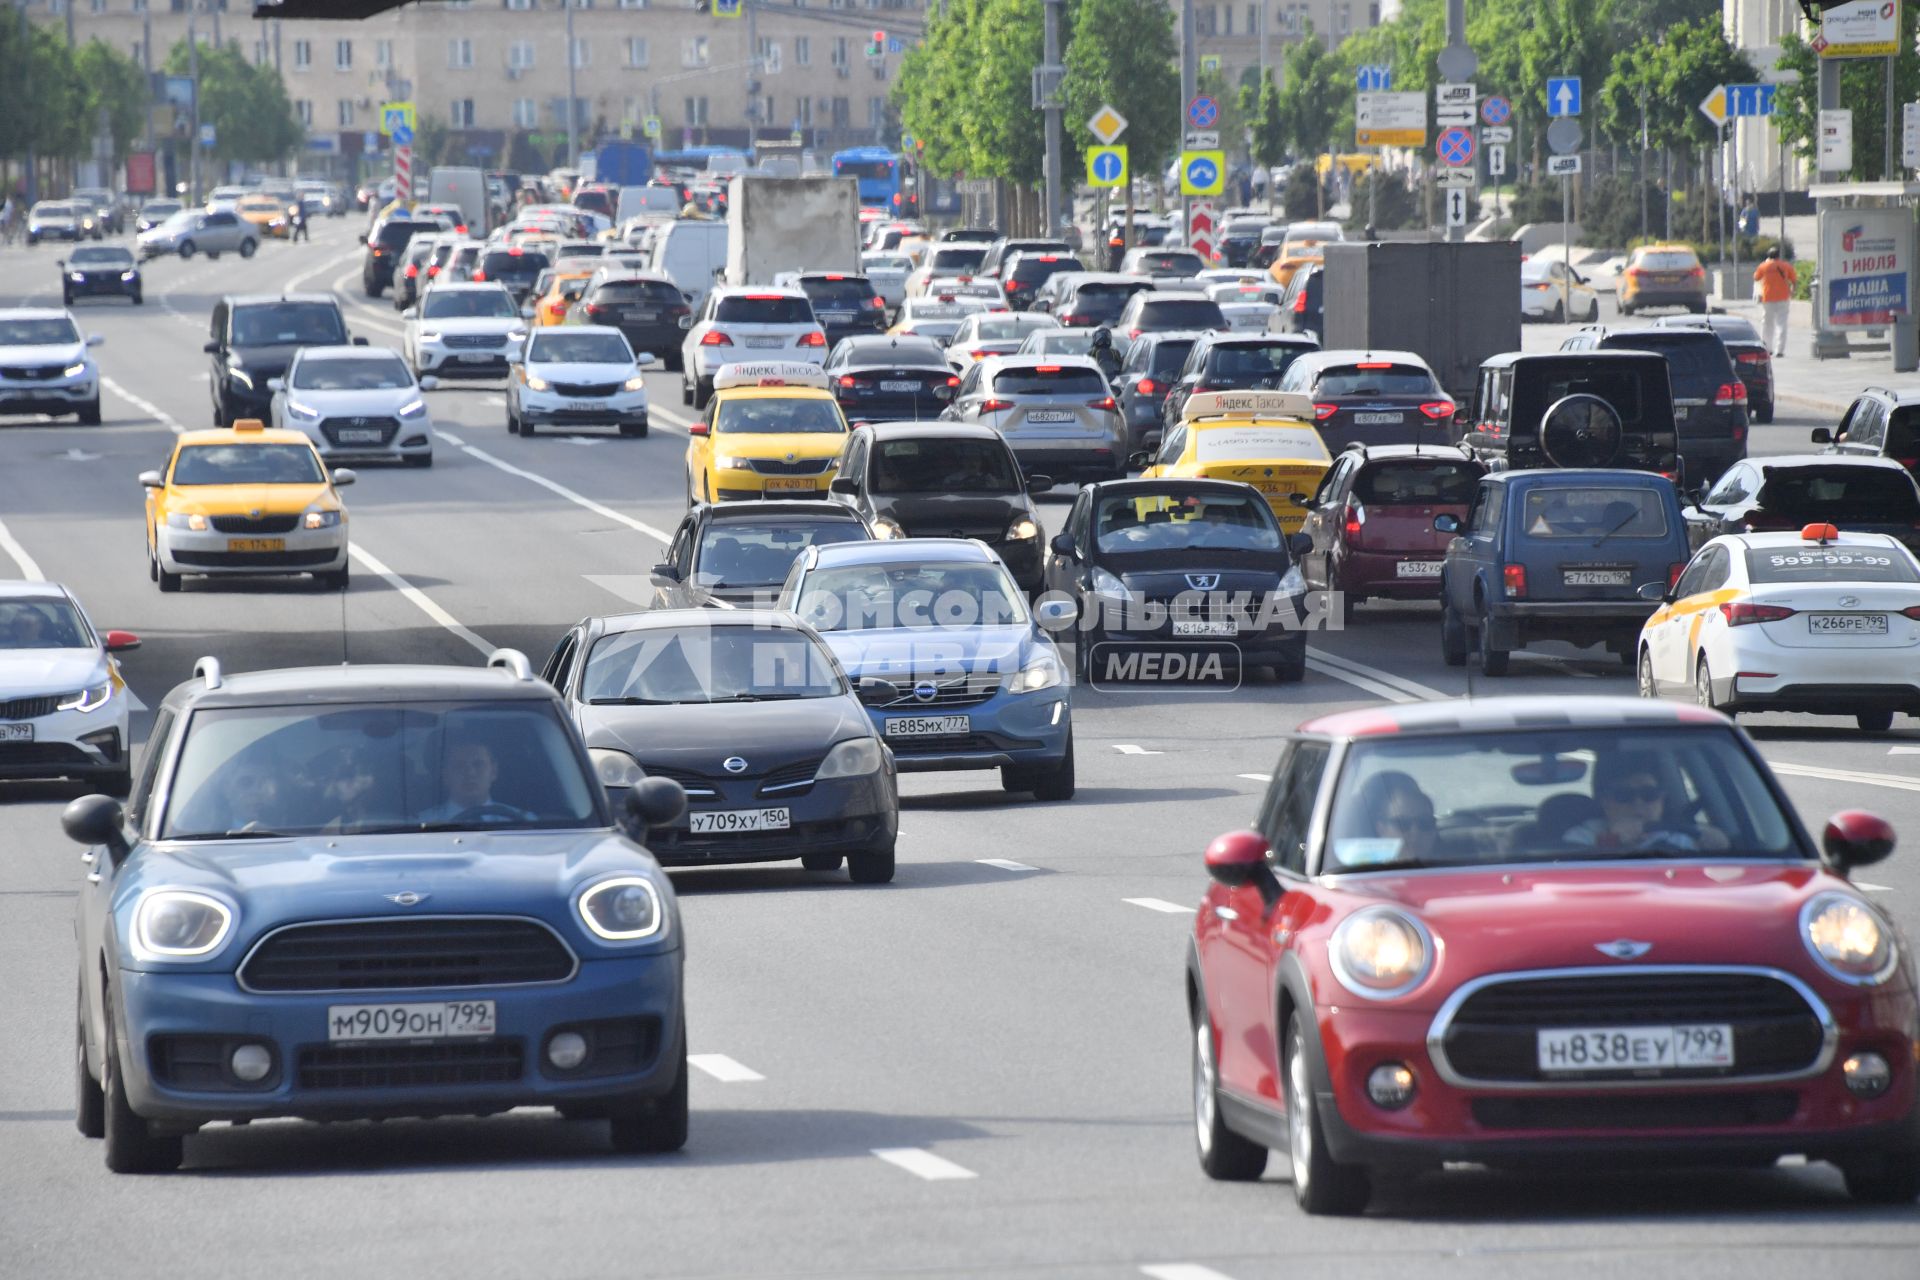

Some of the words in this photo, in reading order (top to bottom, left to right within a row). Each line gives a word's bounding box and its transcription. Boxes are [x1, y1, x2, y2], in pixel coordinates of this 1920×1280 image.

[1842, 260, 1848, 274] 1
[1852, 255, 1896, 272] ИЮЛЯ
[1847, 278, 1888, 297] НАША
[1835, 294, 1902, 311] КОНСТИТУЦИЯ
[734, 364, 777, 376] Яндекс
[781, 364, 812, 375] Такси
[1215, 396, 1252, 410] Яндекс
[1255, 396, 1284, 408] Такси
[1771, 556, 1891, 567] 999-99-99
[1865, 617, 1884, 625] 799
[945, 716, 965, 727] 777
[10, 725, 29, 736] 799
[762, 810, 785, 822] 150
[449, 1003, 487, 1024] 799
[1675, 1028, 1723, 1051] 799
